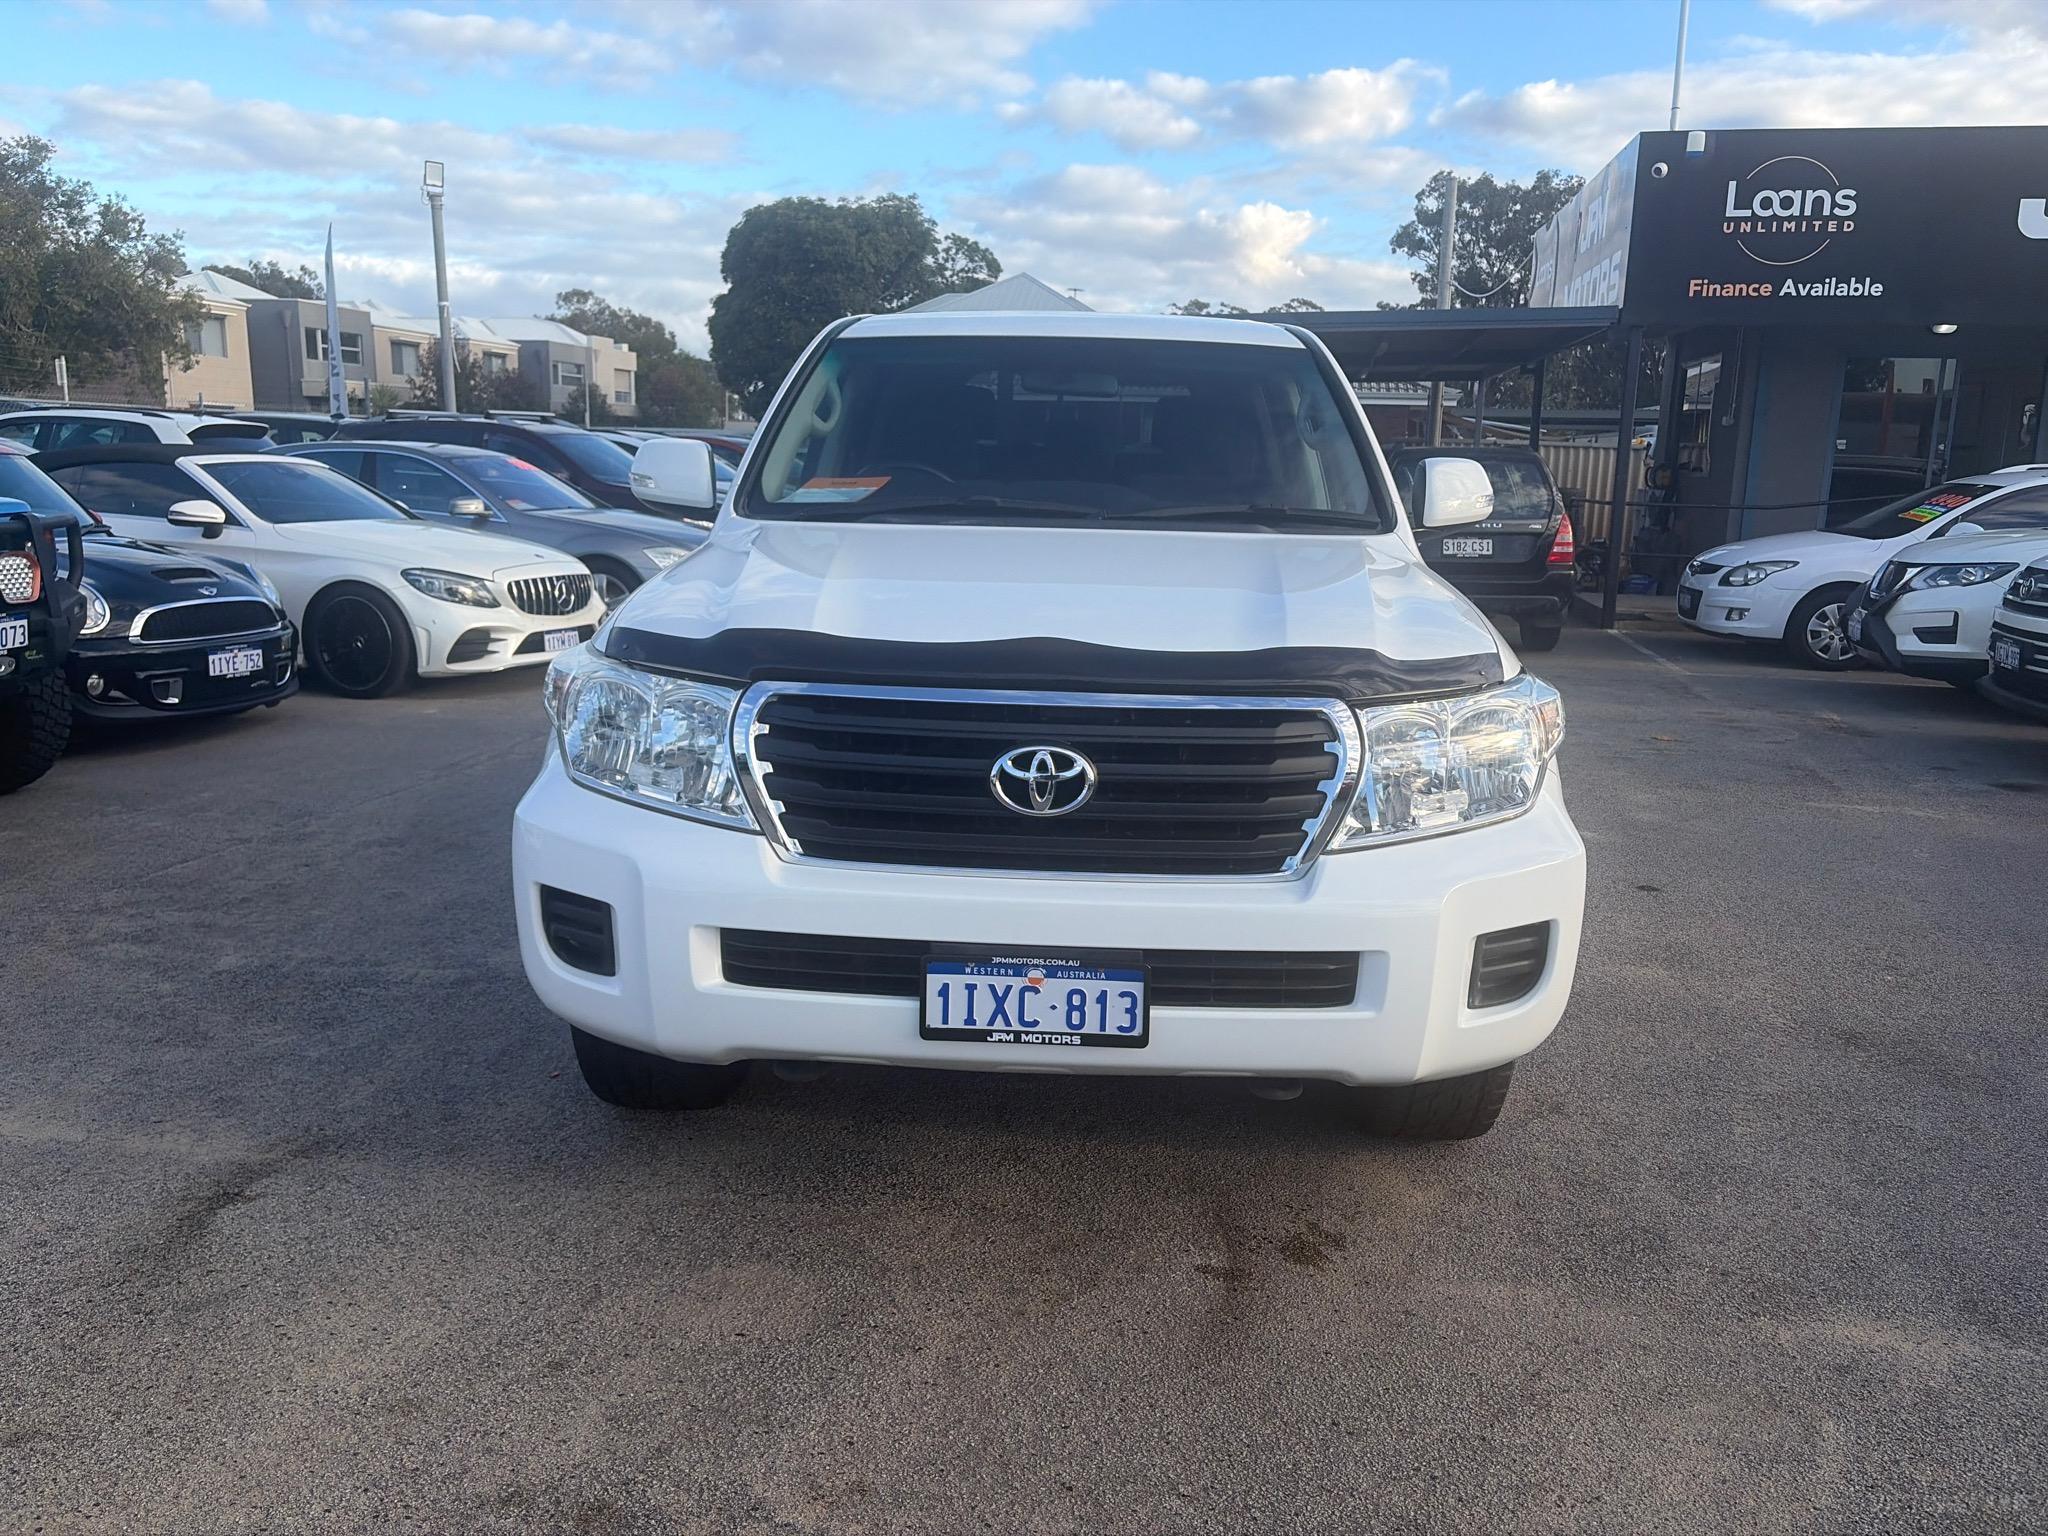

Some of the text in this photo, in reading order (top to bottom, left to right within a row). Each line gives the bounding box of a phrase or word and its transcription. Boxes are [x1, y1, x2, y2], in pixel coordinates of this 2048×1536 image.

[1725, 180, 1857, 217] Loans
[1723, 220, 1855, 233] UNLIMITED
[1689, 277, 1884, 297] Finance Available
[991, 956, 1080, 967] JPMMOTORS.COM.AU
[964, 966, 1106, 980] WESTERN AUSTRALIA
[987, 1031, 1081, 1045] JPM MOTORS
